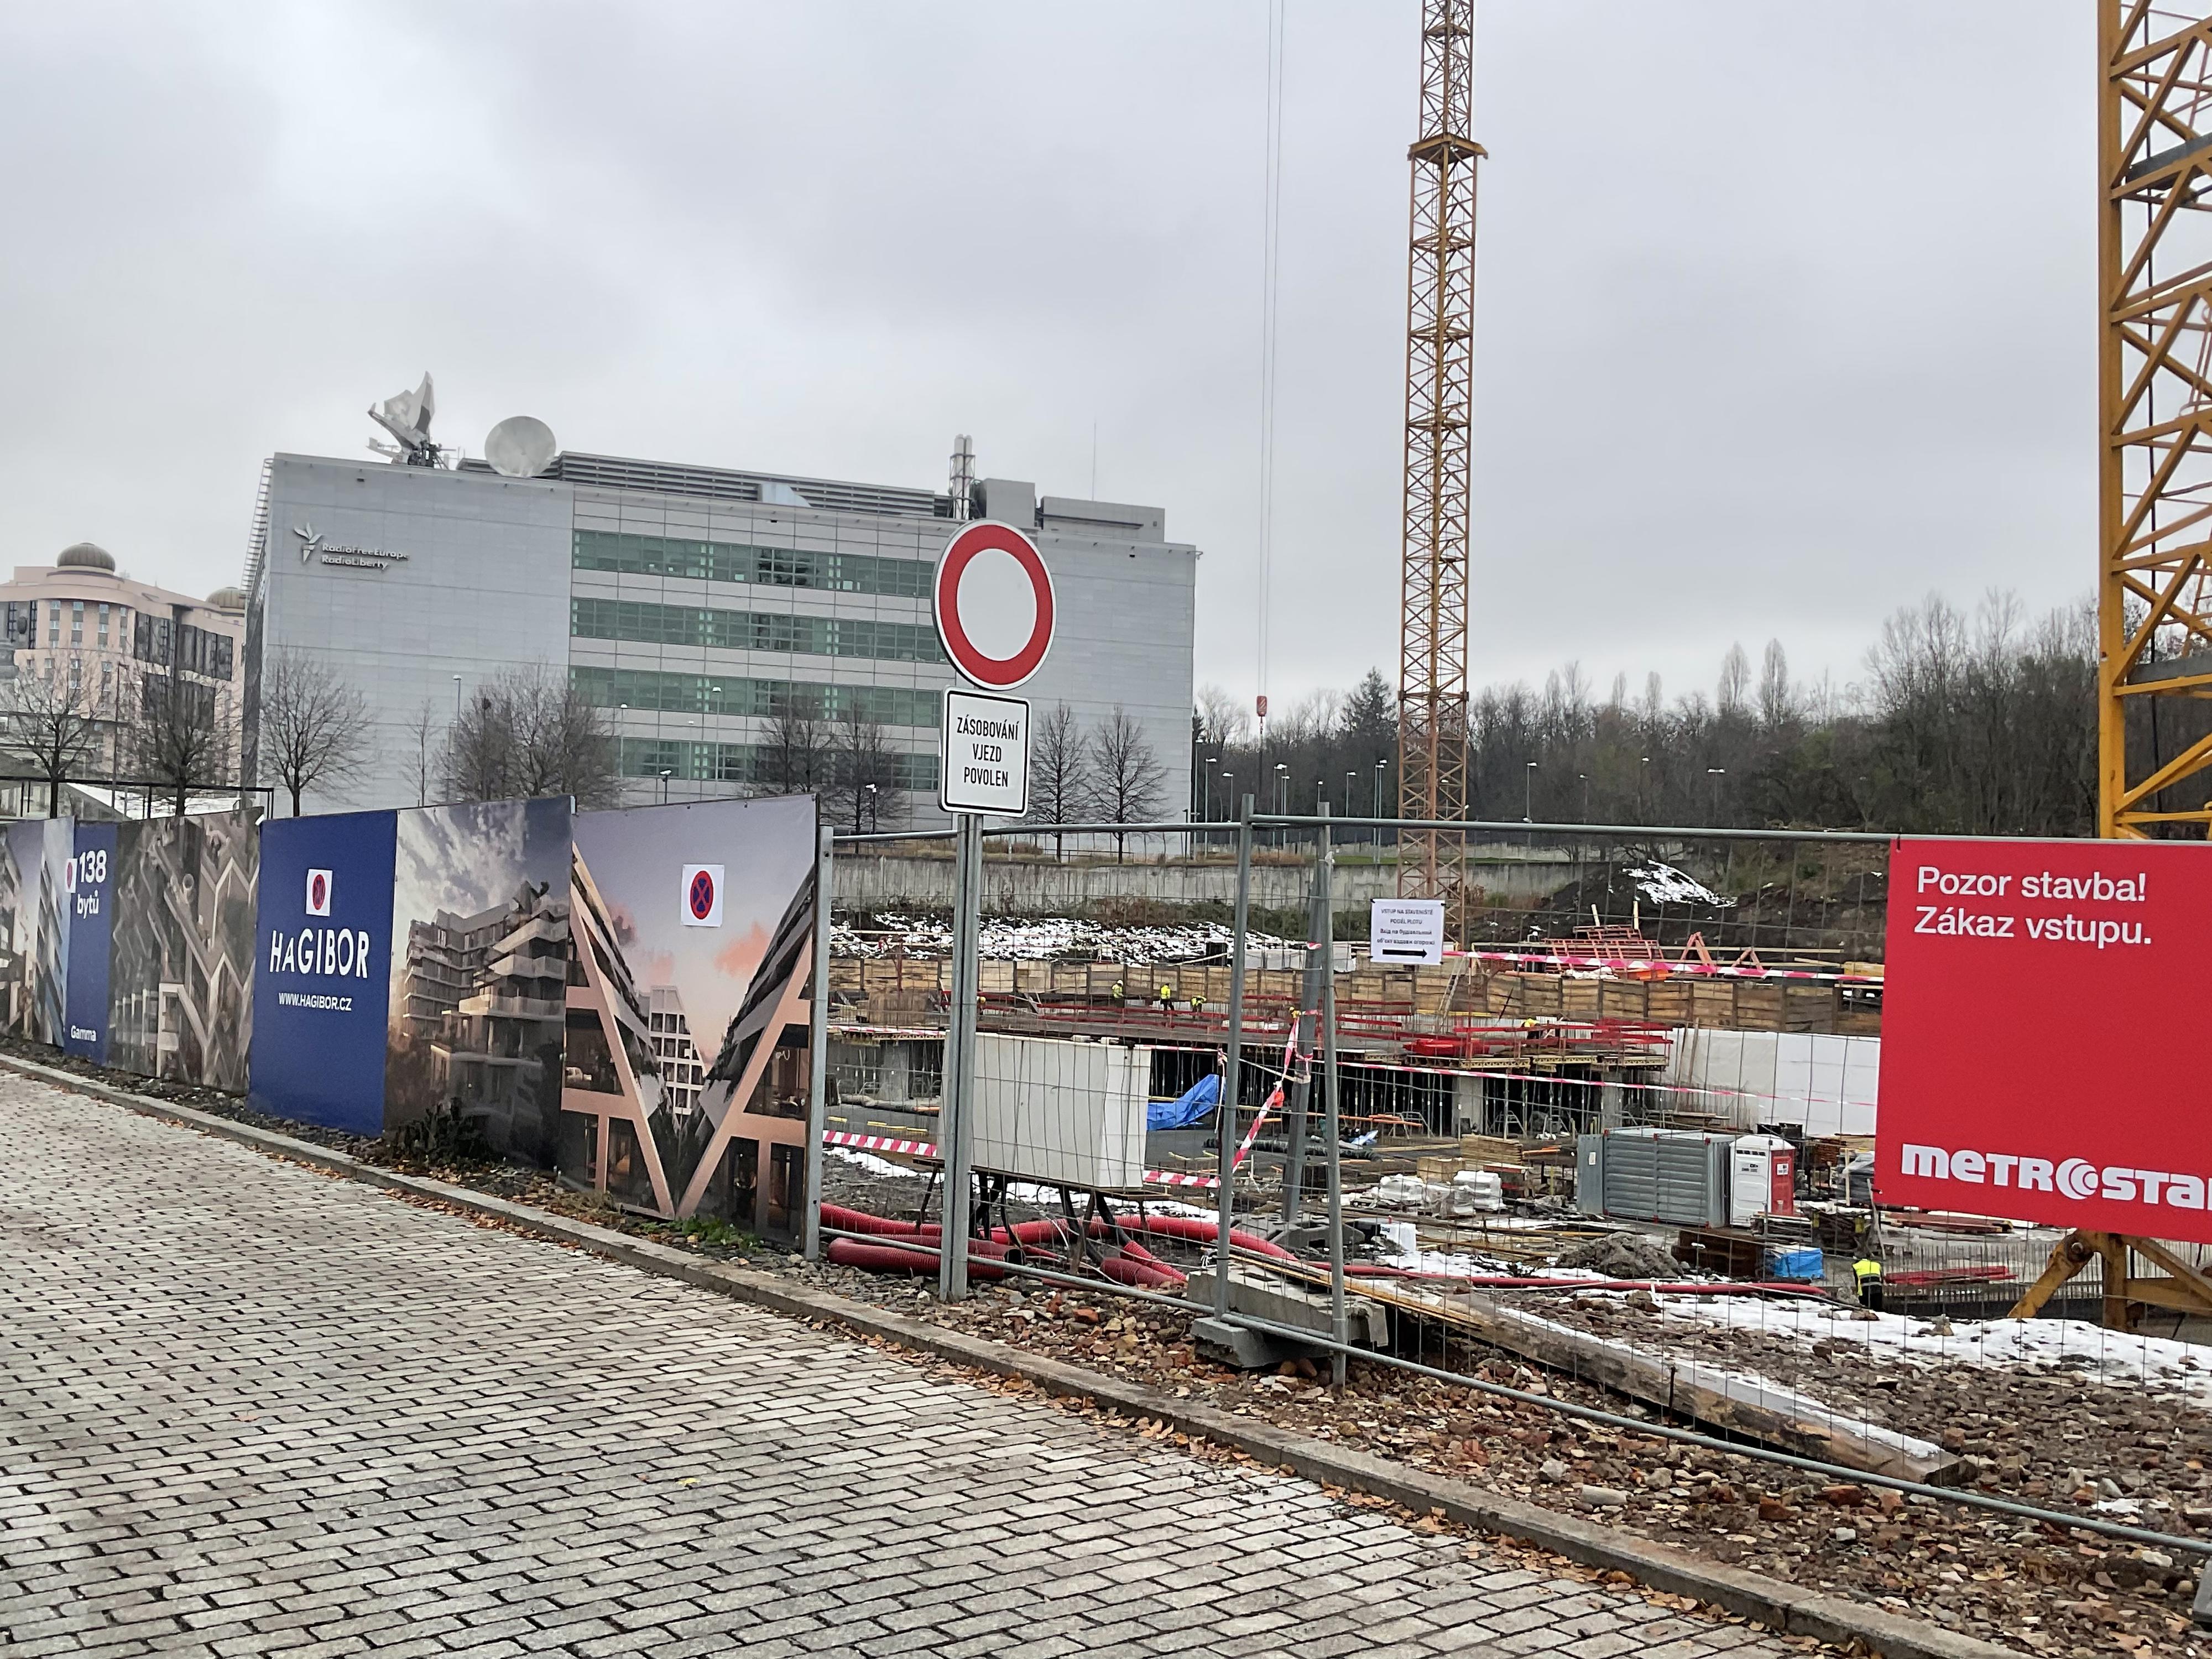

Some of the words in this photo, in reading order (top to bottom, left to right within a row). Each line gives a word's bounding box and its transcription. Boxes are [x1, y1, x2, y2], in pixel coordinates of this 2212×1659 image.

[322, 555, 388, 570] RadioLiberty
[957, 714, 1019, 740] ZÁSOBOVÁNÍ
[972, 743, 1001, 763] VJEZD
[964, 767, 1008, 787] POVOLEN
[79, 849, 107, 883] 138
[1917, 865, 2012, 896] Pozor
[2021, 872, 2146, 901] stavba!
[77, 889, 98, 919] bytů
[1914, 905, 2015, 937] Zákaz
[2025, 914, 2151, 949] vstupu.
[270, 928, 369, 978] HAGIBOR
[279, 993, 352, 1011] WWW.HAGIBOR.CZ
[71, 1025, 96, 1041] Gamma
